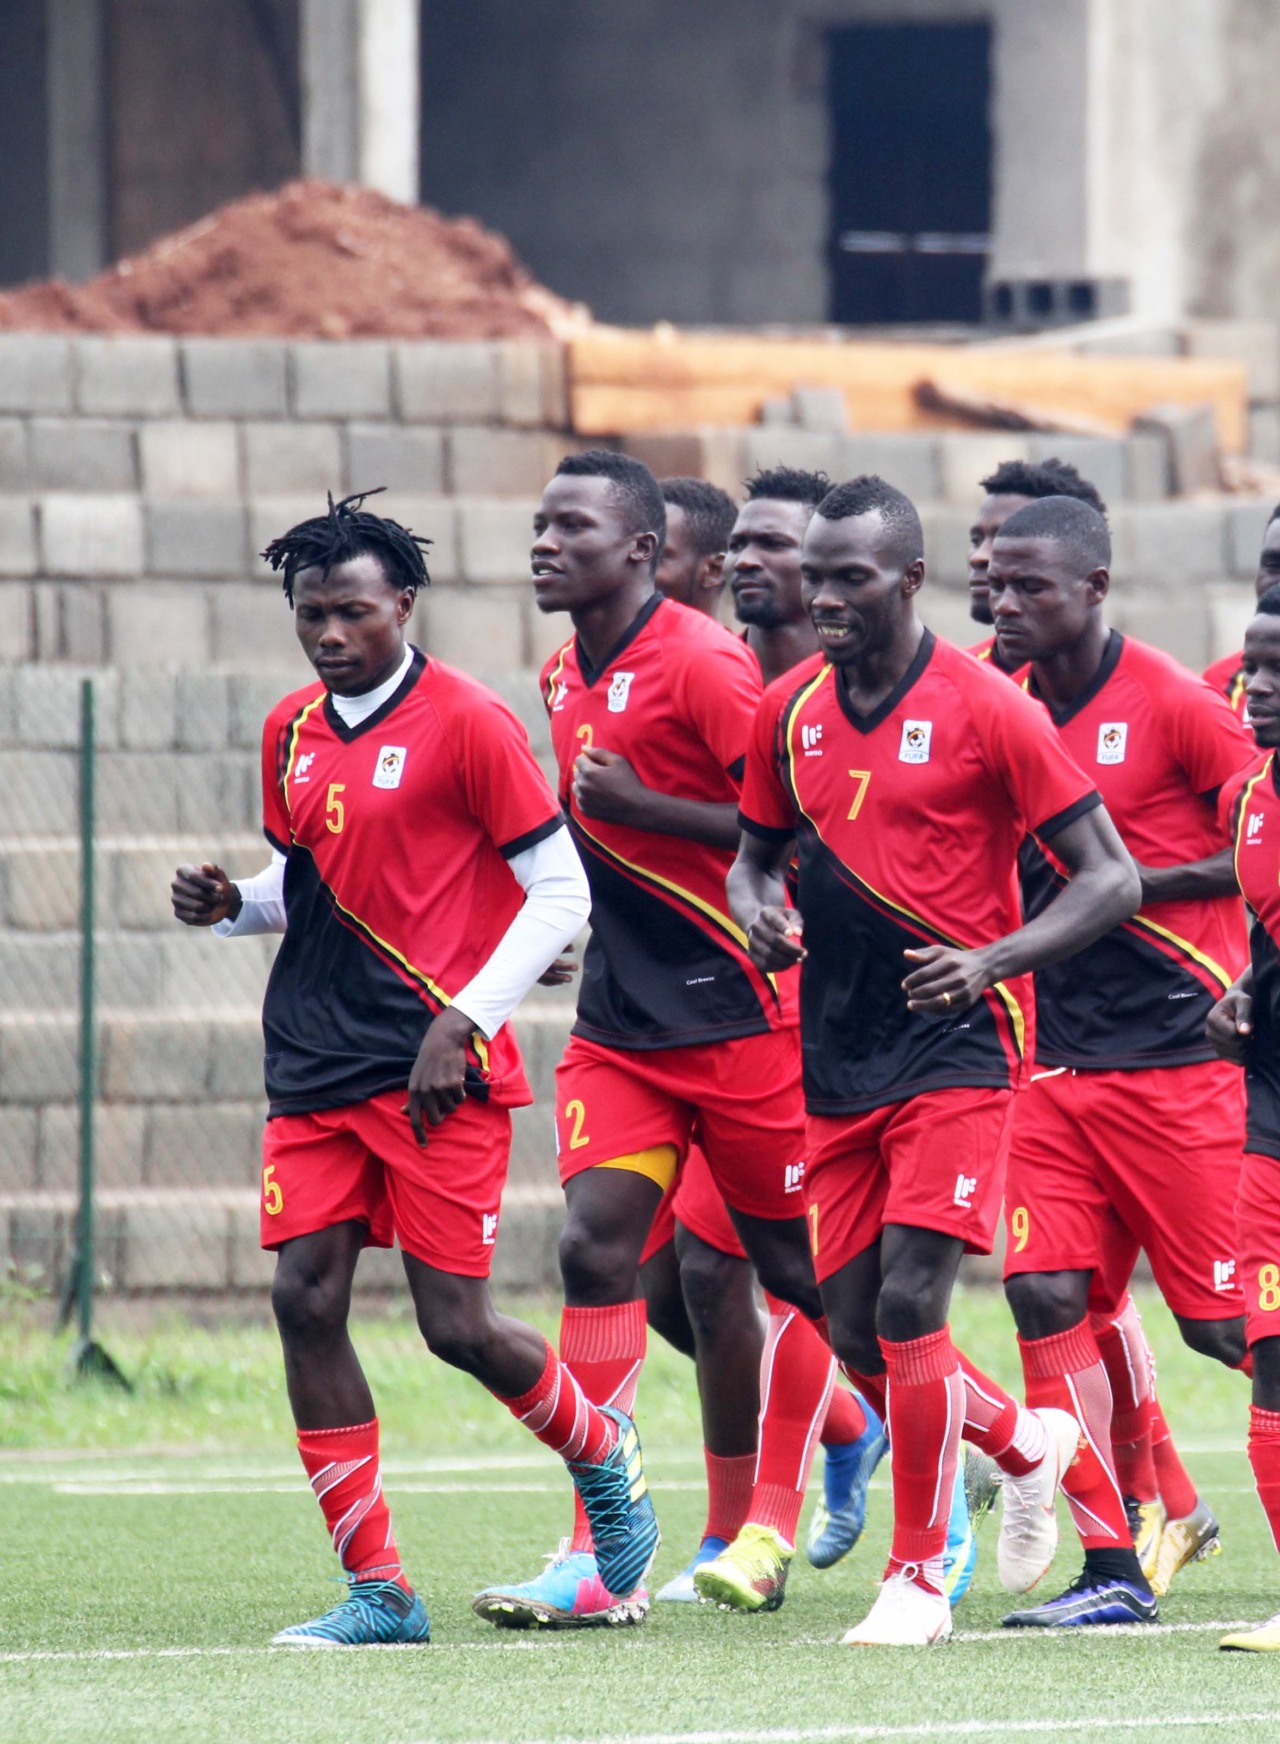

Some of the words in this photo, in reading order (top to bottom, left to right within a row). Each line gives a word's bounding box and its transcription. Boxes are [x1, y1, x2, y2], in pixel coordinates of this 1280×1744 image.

[904, 753, 923, 761] FUFA
[1102, 753, 1119, 761] FUFA
[325, 783, 345, 834] 5
[847, 769, 871, 820] 7
[565, 1099, 589, 1149] 2
[263, 1165, 283, 1215] 5
[1012, 1206, 1028, 1252] 9
